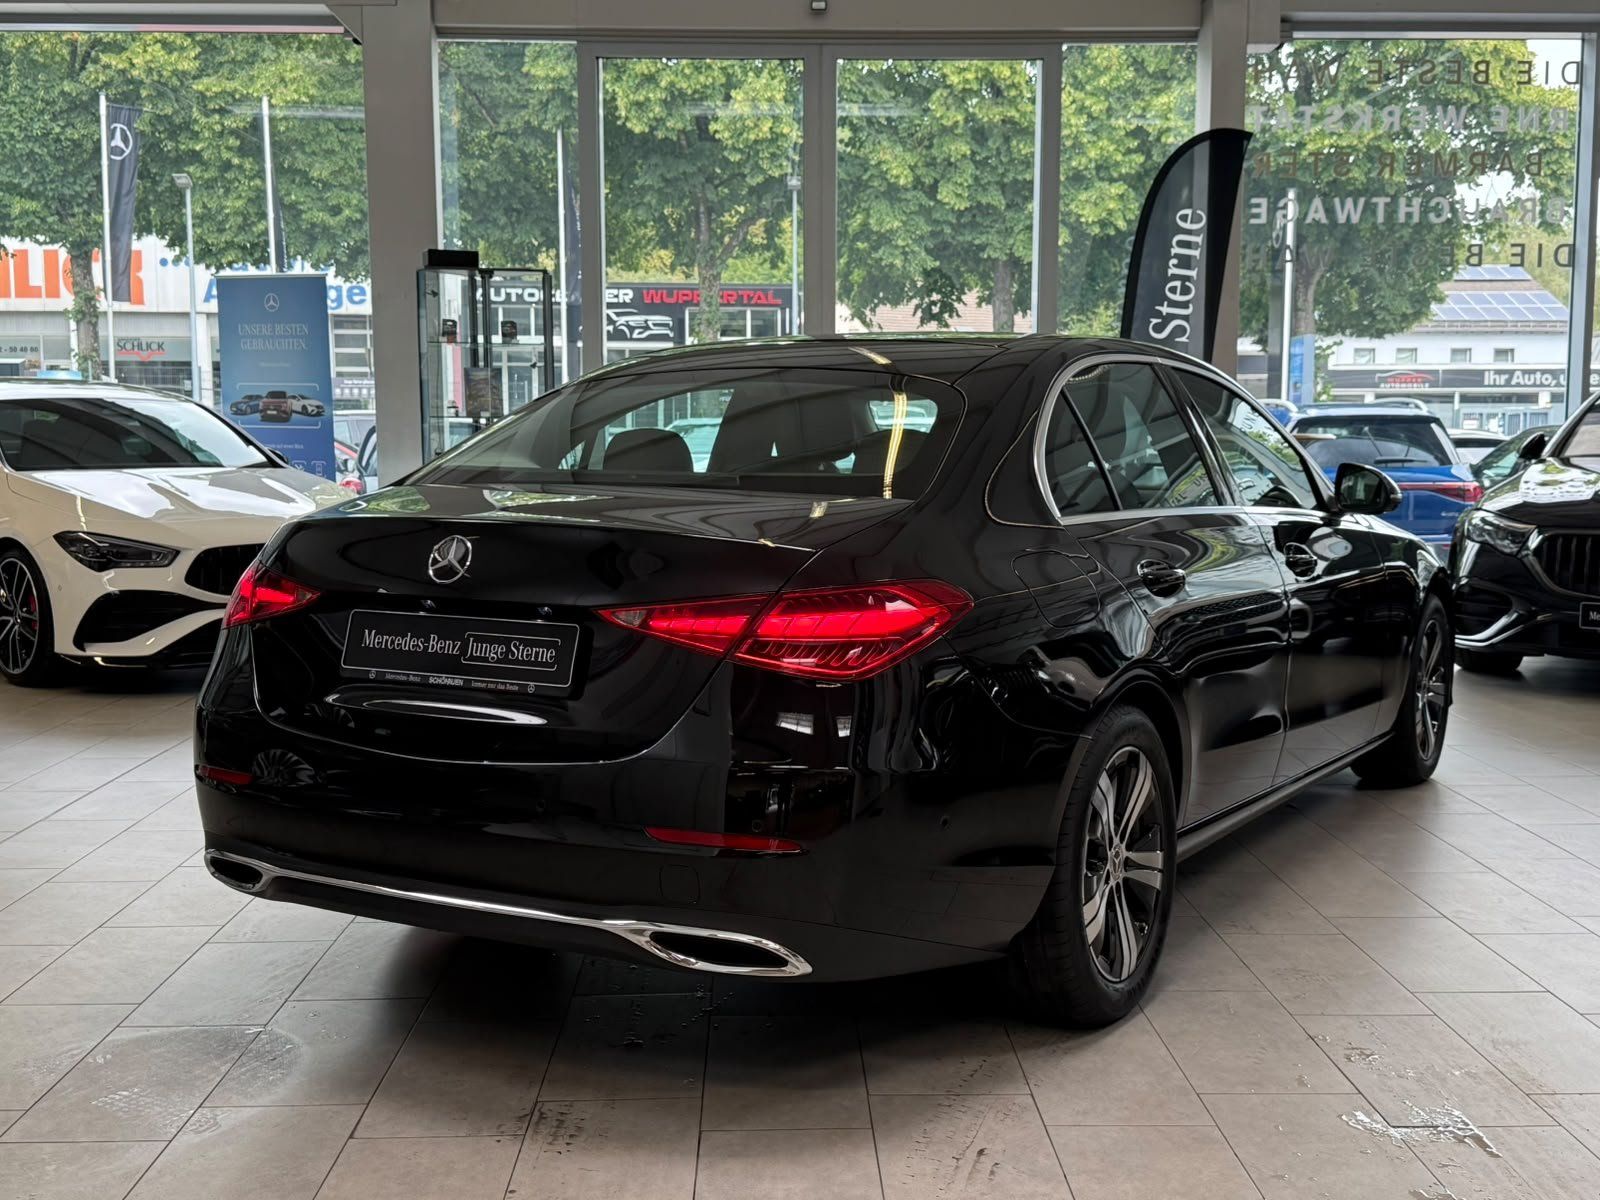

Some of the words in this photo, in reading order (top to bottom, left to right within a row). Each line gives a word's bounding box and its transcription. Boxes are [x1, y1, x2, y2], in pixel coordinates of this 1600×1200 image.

[1149, 208, 1207, 343] Sterne
[238, 323, 272, 335] UNSERE
[275, 324, 309, 336] BESTEN
[116, 340, 165, 352] SCHLICK
[1484, 371, 1507, 385] Ihr
[1511, 371, 1557, 387] Auto,
[361, 629, 461, 655] Mercedes-Benz
[465, 637, 506, 662] Junge
[508, 640, 556, 662] Sterne
